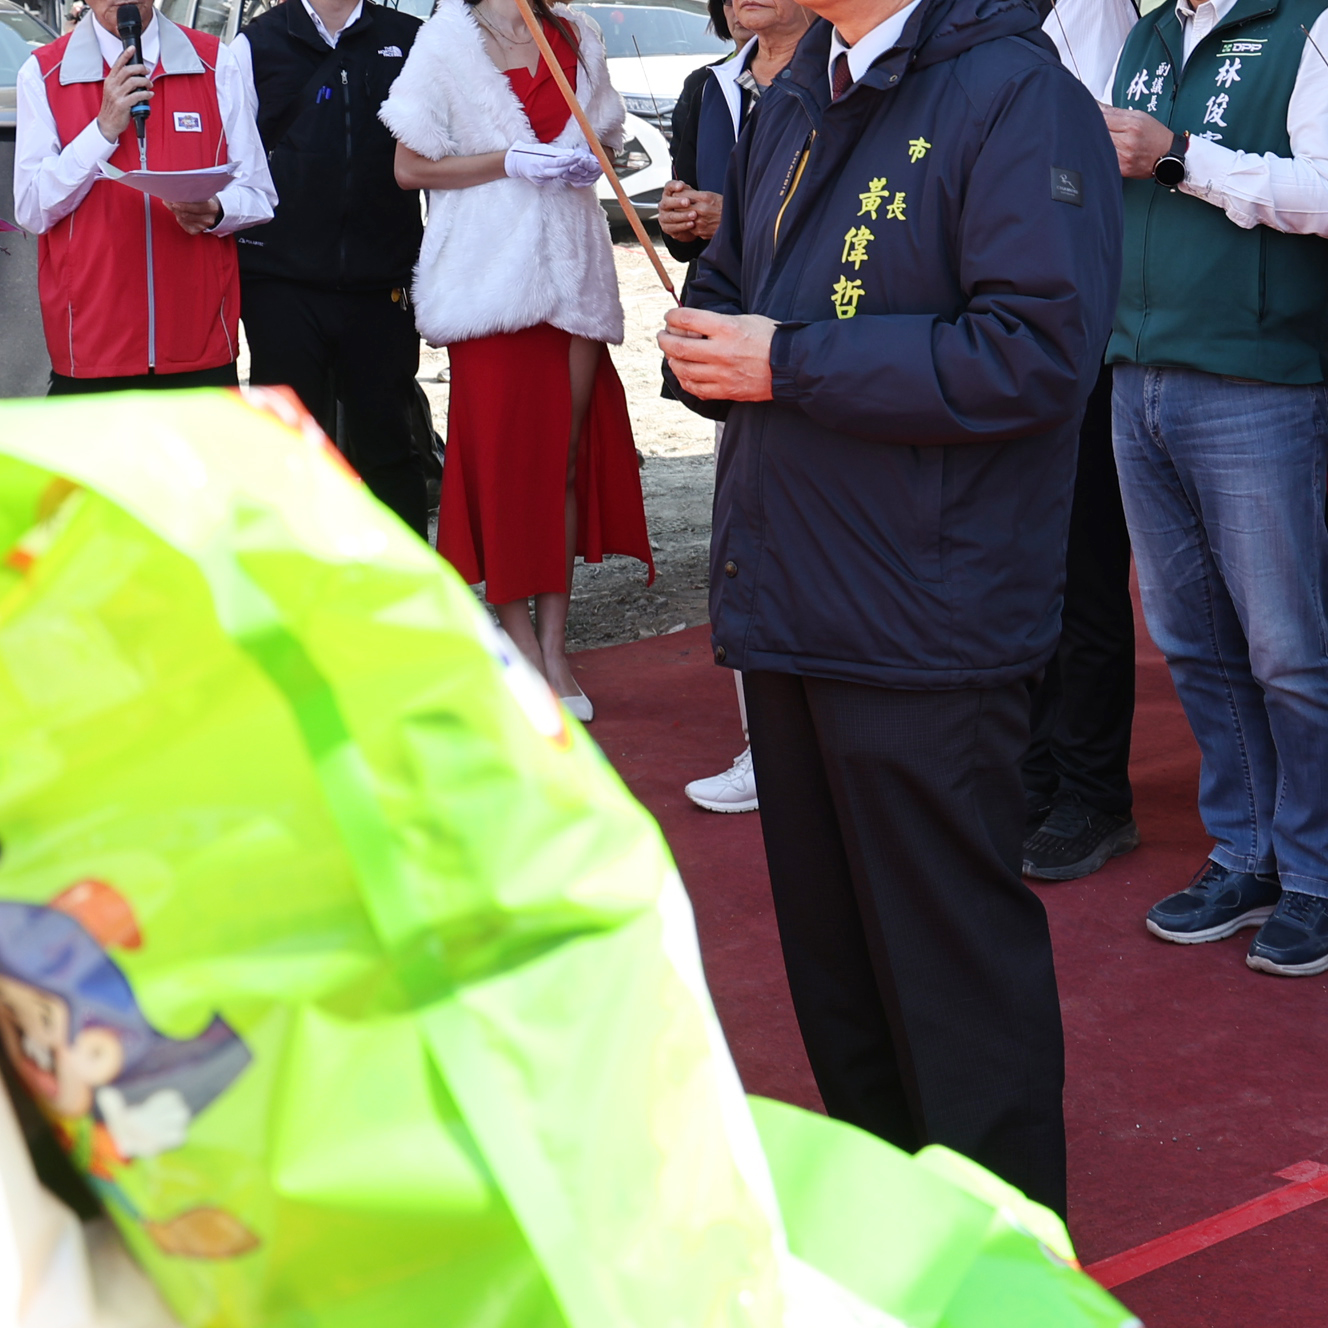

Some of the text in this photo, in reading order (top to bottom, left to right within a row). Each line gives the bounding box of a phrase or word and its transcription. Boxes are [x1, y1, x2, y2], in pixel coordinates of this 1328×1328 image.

[1231, 43, 1263, 52] DPP
[1125, 68, 1150, 111] 林
[1146, 61, 1171, 113] 副議長
[886, 136, 932, 221] 市長
[830, 176, 890, 320] 黃偉哲
